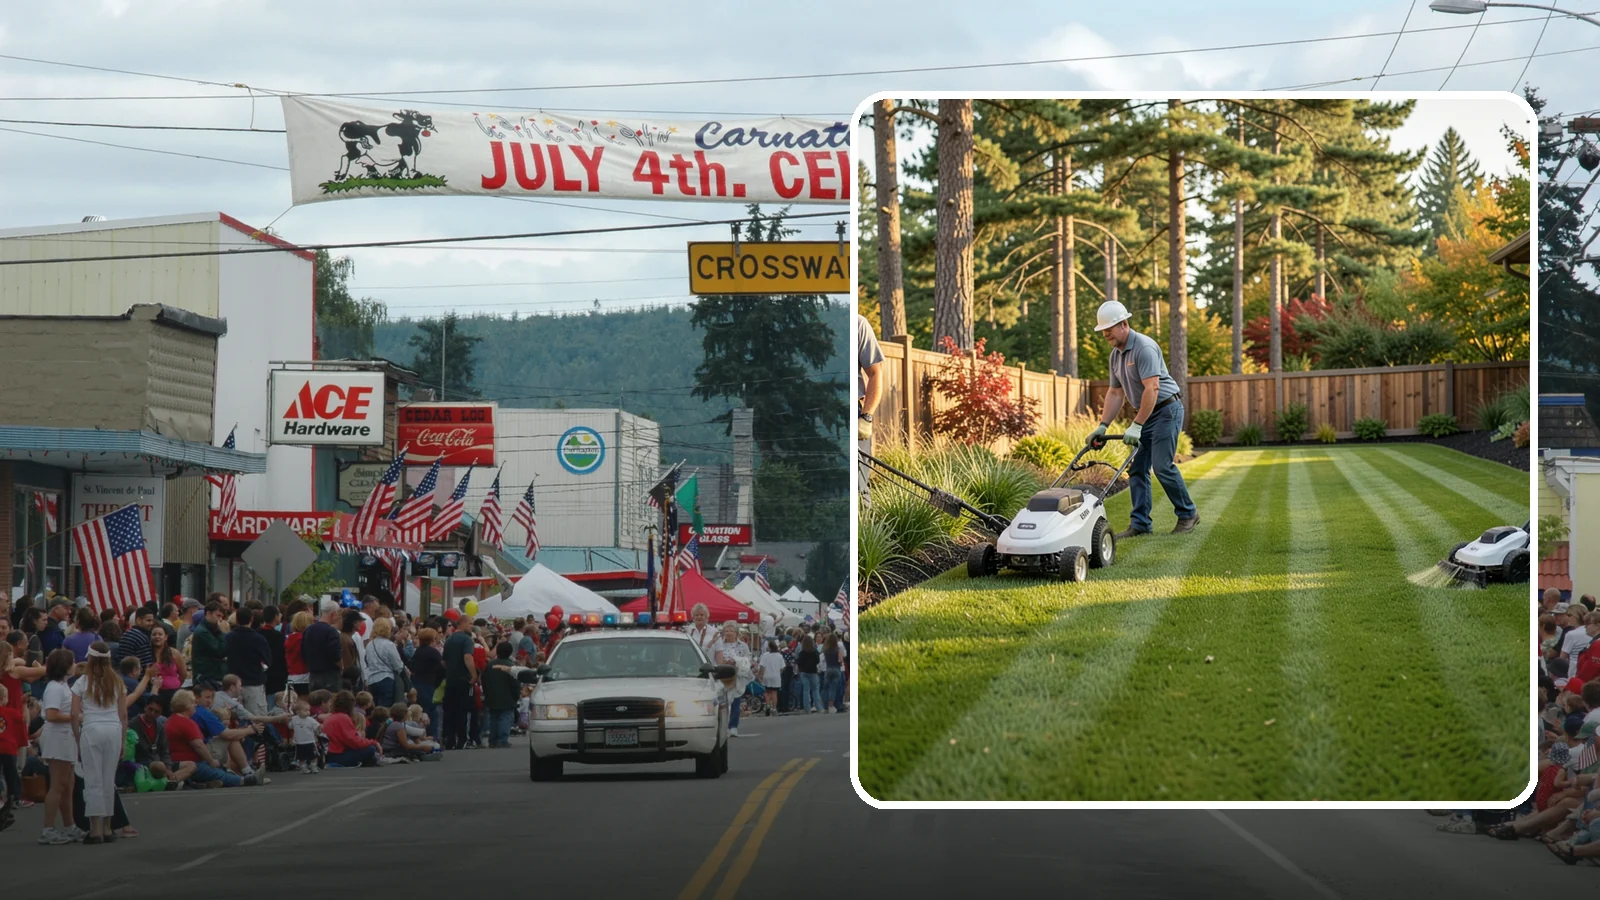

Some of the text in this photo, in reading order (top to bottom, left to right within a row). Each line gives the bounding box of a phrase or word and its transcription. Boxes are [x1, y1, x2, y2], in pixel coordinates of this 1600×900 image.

[481, 141, 604, 192] JULY
[632, 150, 746, 198] 4th.
[696, 254, 850, 280] CROSSWA
[282, 380, 373, 420] ACE
[405, 409, 485, 422] CEDAR LOG
[283, 421, 371, 436] Hardware
[416, 428, 477, 447] Coca-Cola
[353, 467, 388, 480] Simpl
[95, 484, 124, 495] Vincent
[126, 486, 136, 495] de
[137, 486, 155, 495] Paul
[212, 516, 331, 536] HARDARE
[688, 526, 741, 535] CRNATION
[699, 535, 730, 543] GLASS
